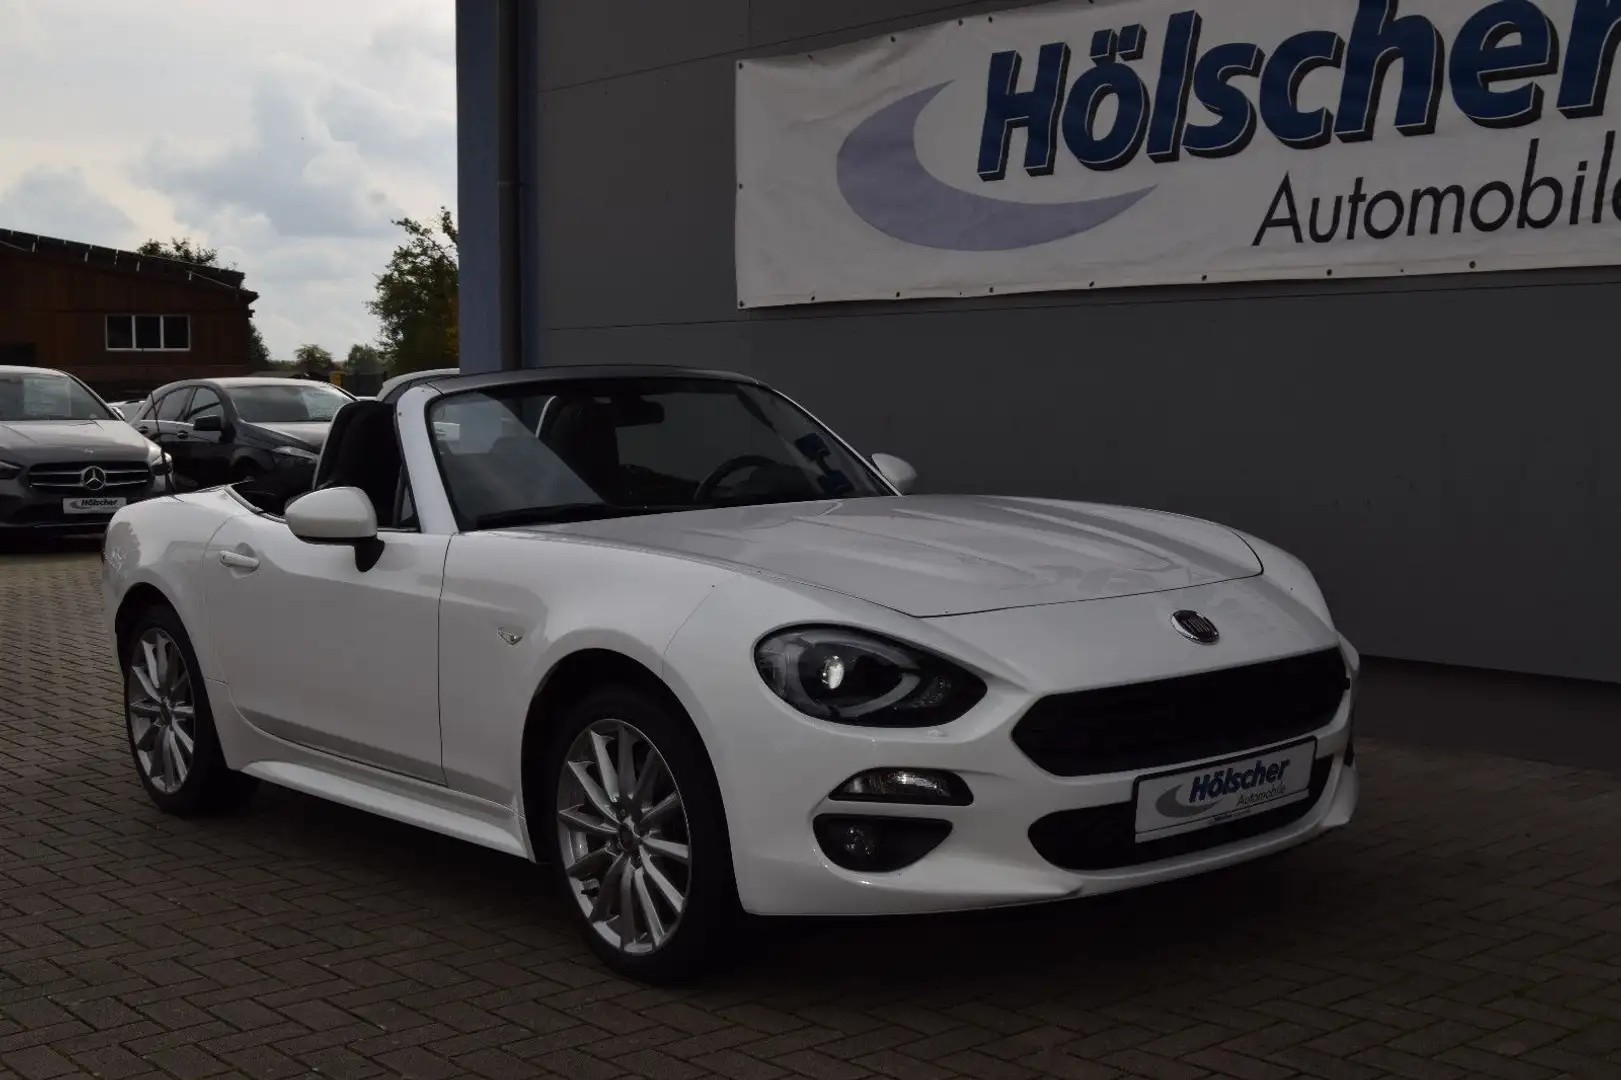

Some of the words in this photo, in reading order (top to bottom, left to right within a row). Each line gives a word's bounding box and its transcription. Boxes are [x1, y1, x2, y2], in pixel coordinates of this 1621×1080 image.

[976, 0, 1621, 182] Hölscher
[1252, 131, 1621, 247] Automobil
[1188, 758, 1291, 804] Hölscher
[1235, 782, 1287, 808] Automobile
